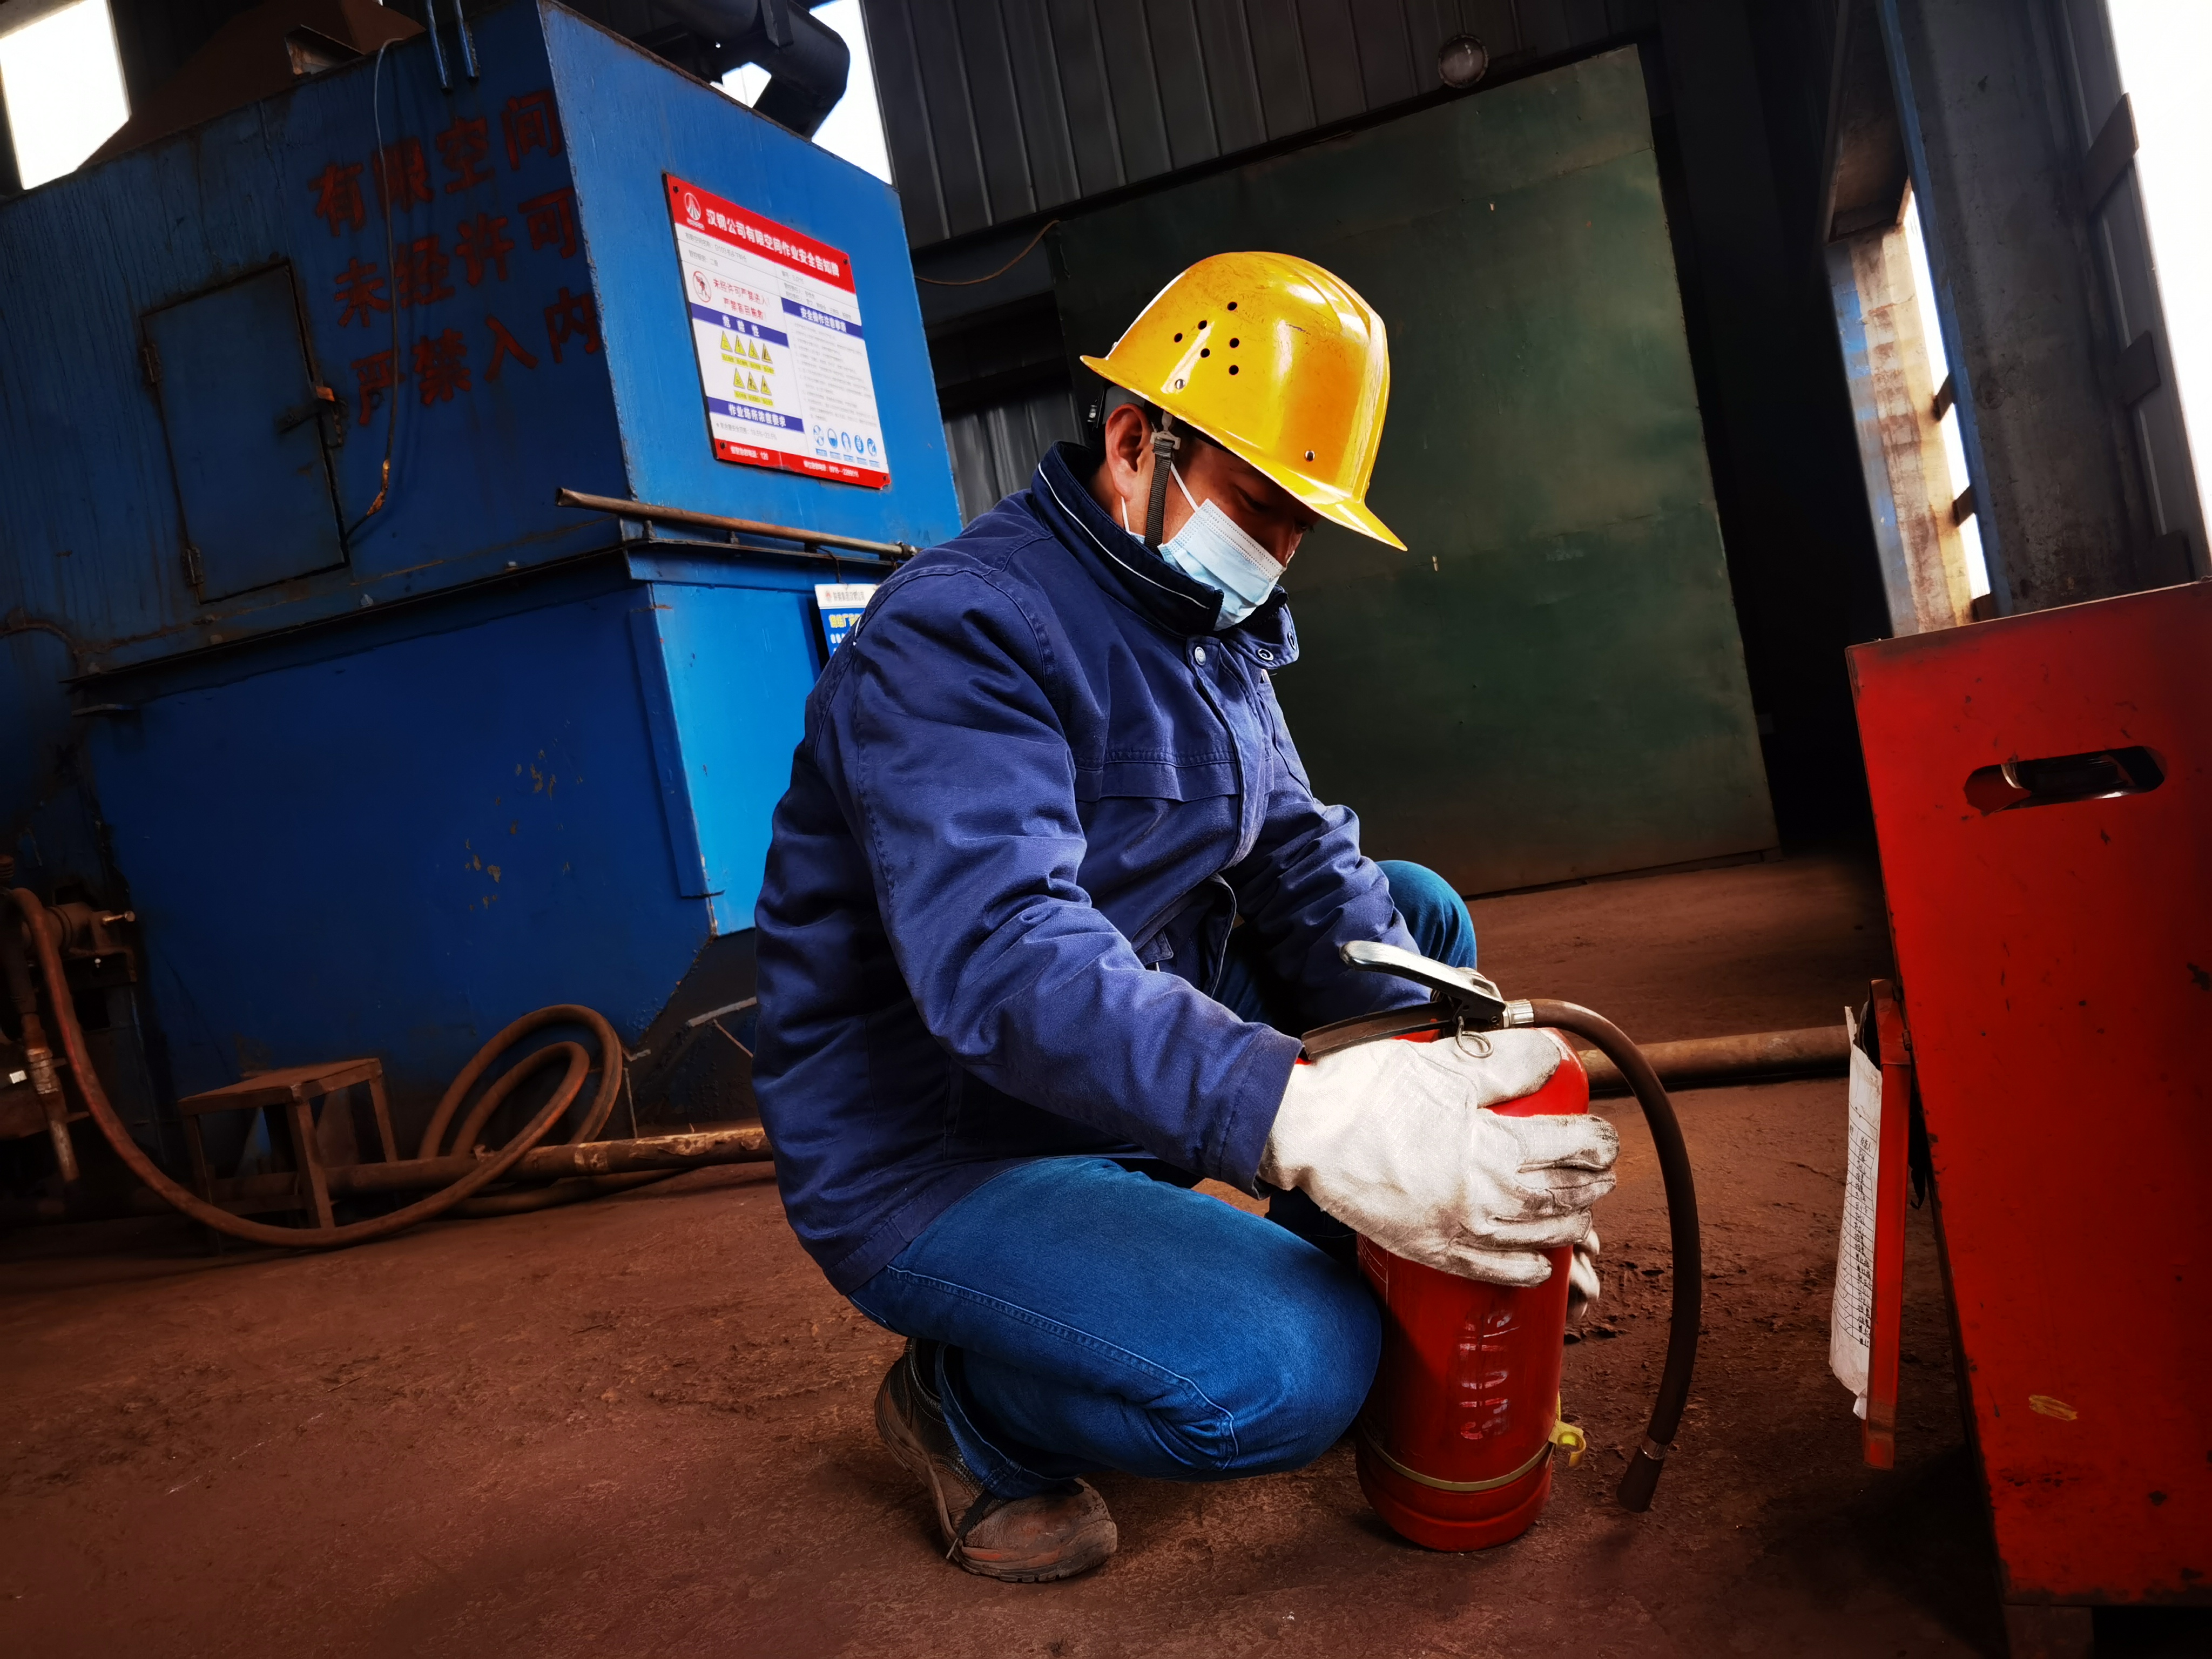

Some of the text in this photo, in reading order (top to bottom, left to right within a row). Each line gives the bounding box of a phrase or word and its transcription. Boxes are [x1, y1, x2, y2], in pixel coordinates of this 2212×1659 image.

[308, 90, 563, 238] 有限空间
[334, 188, 577, 328] 未经许可
[350, 287, 601, 426] 严禁入内
